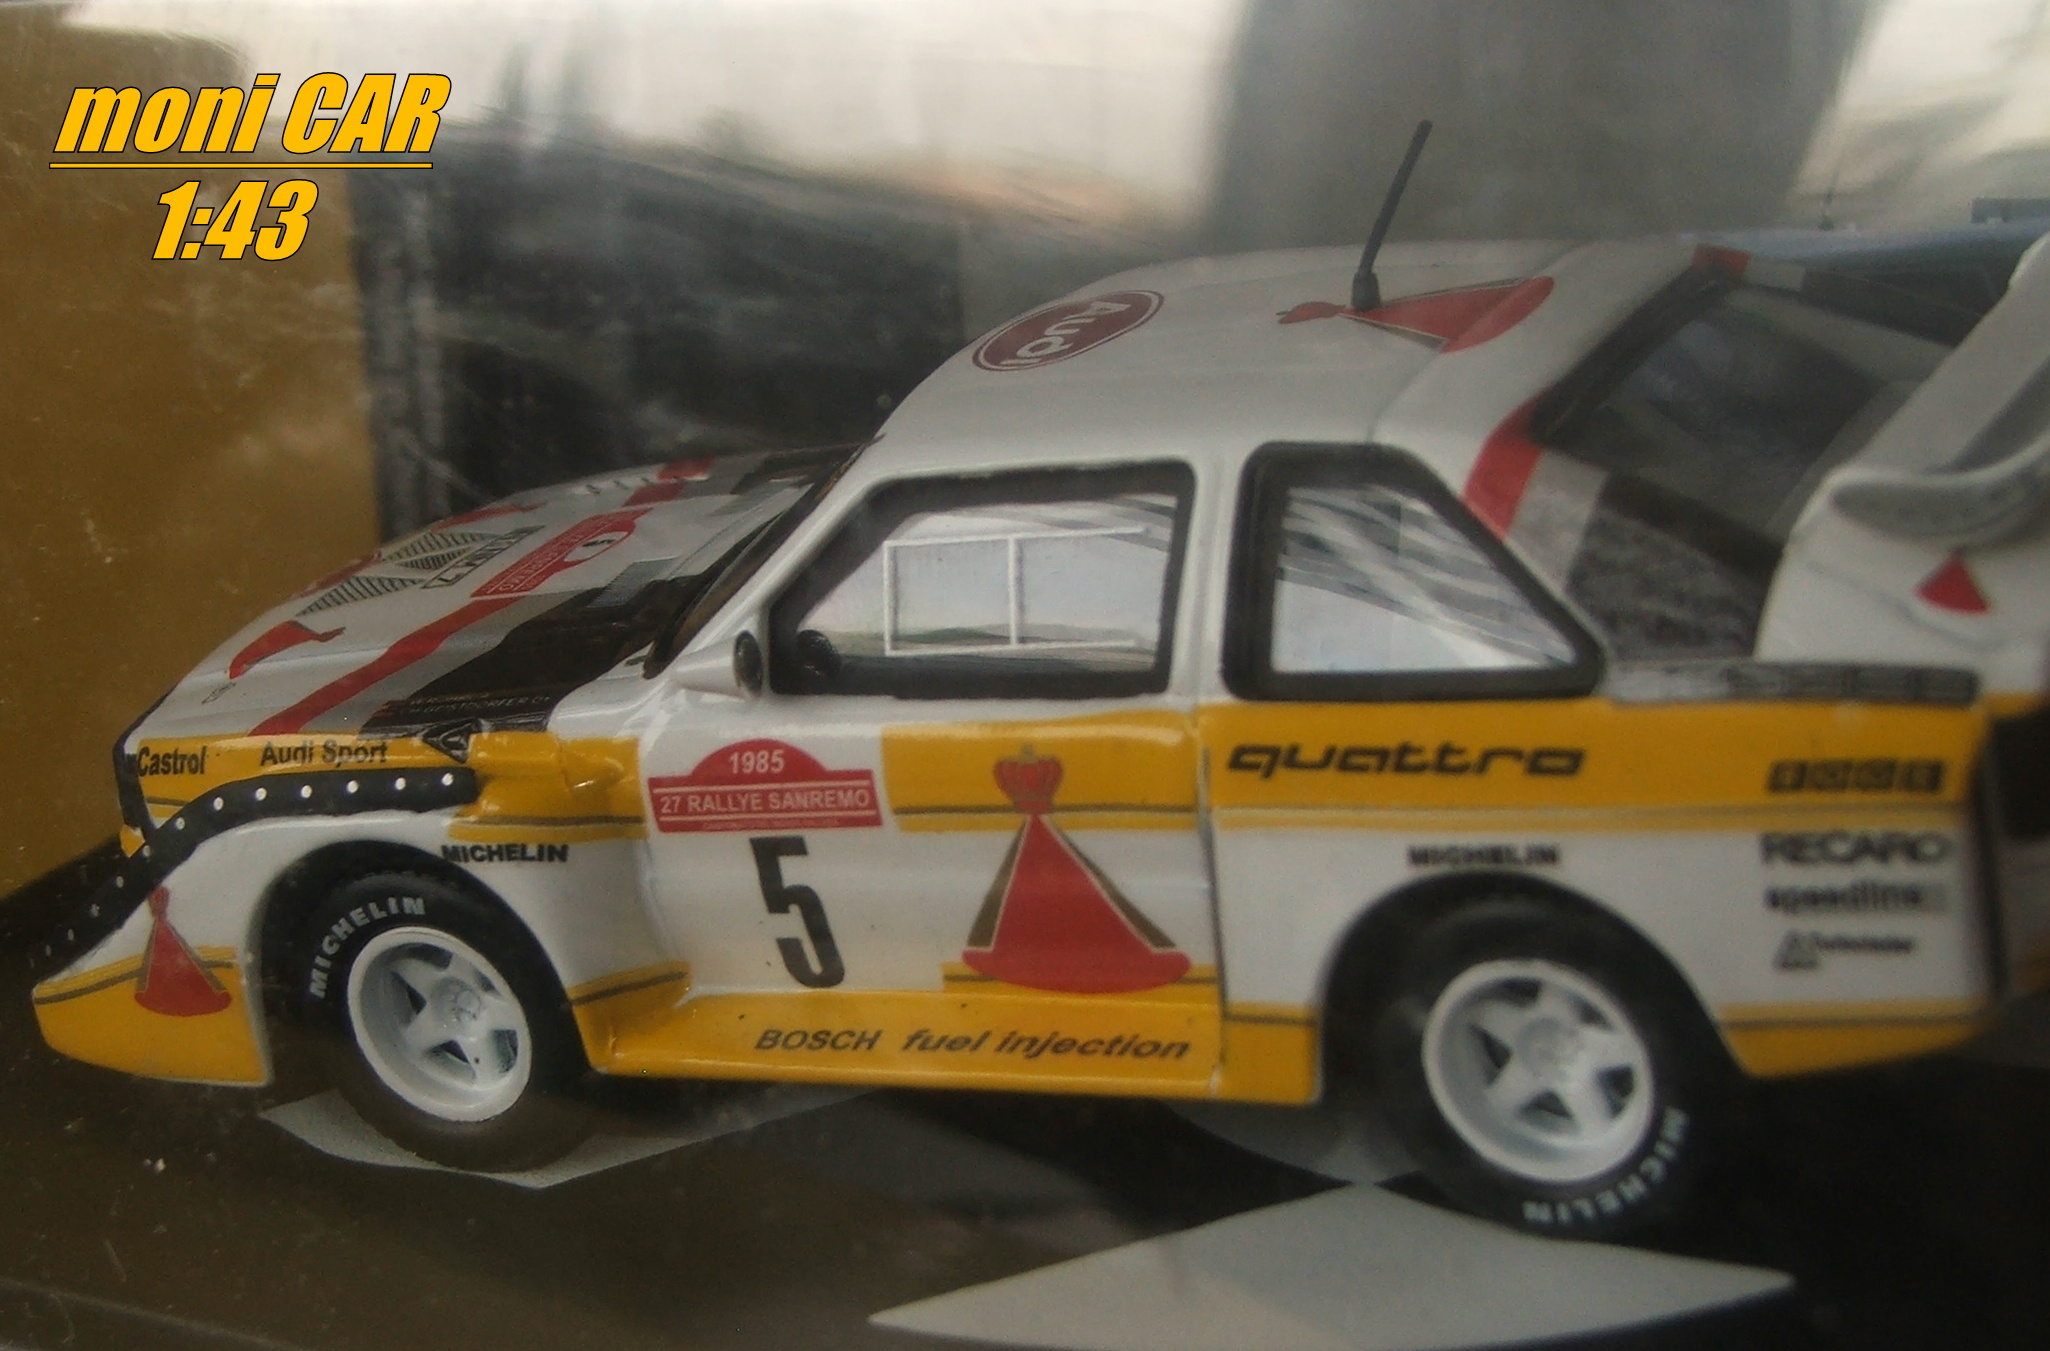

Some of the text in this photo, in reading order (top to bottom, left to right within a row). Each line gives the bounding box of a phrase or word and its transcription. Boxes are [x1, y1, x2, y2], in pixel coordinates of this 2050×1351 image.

[1000, 301, 1132, 366] Audi
[137, 745, 208, 777] Castrol
[260, 739, 389, 767] Audi Sport
[729, 750, 786, 775] 1985
[1227, 740, 1587, 780] quattro
[660, 788, 871, 815] 27 RALLYE SANREMO
[441, 843, 570, 864] MICHELIN
[1760, 831, 1956, 868] RECARO
[748, 835, 847, 989] 5
[309, 896, 427, 999] MICHELIN
[754, 1028, 1192, 1060] BOSCH fuel injection
